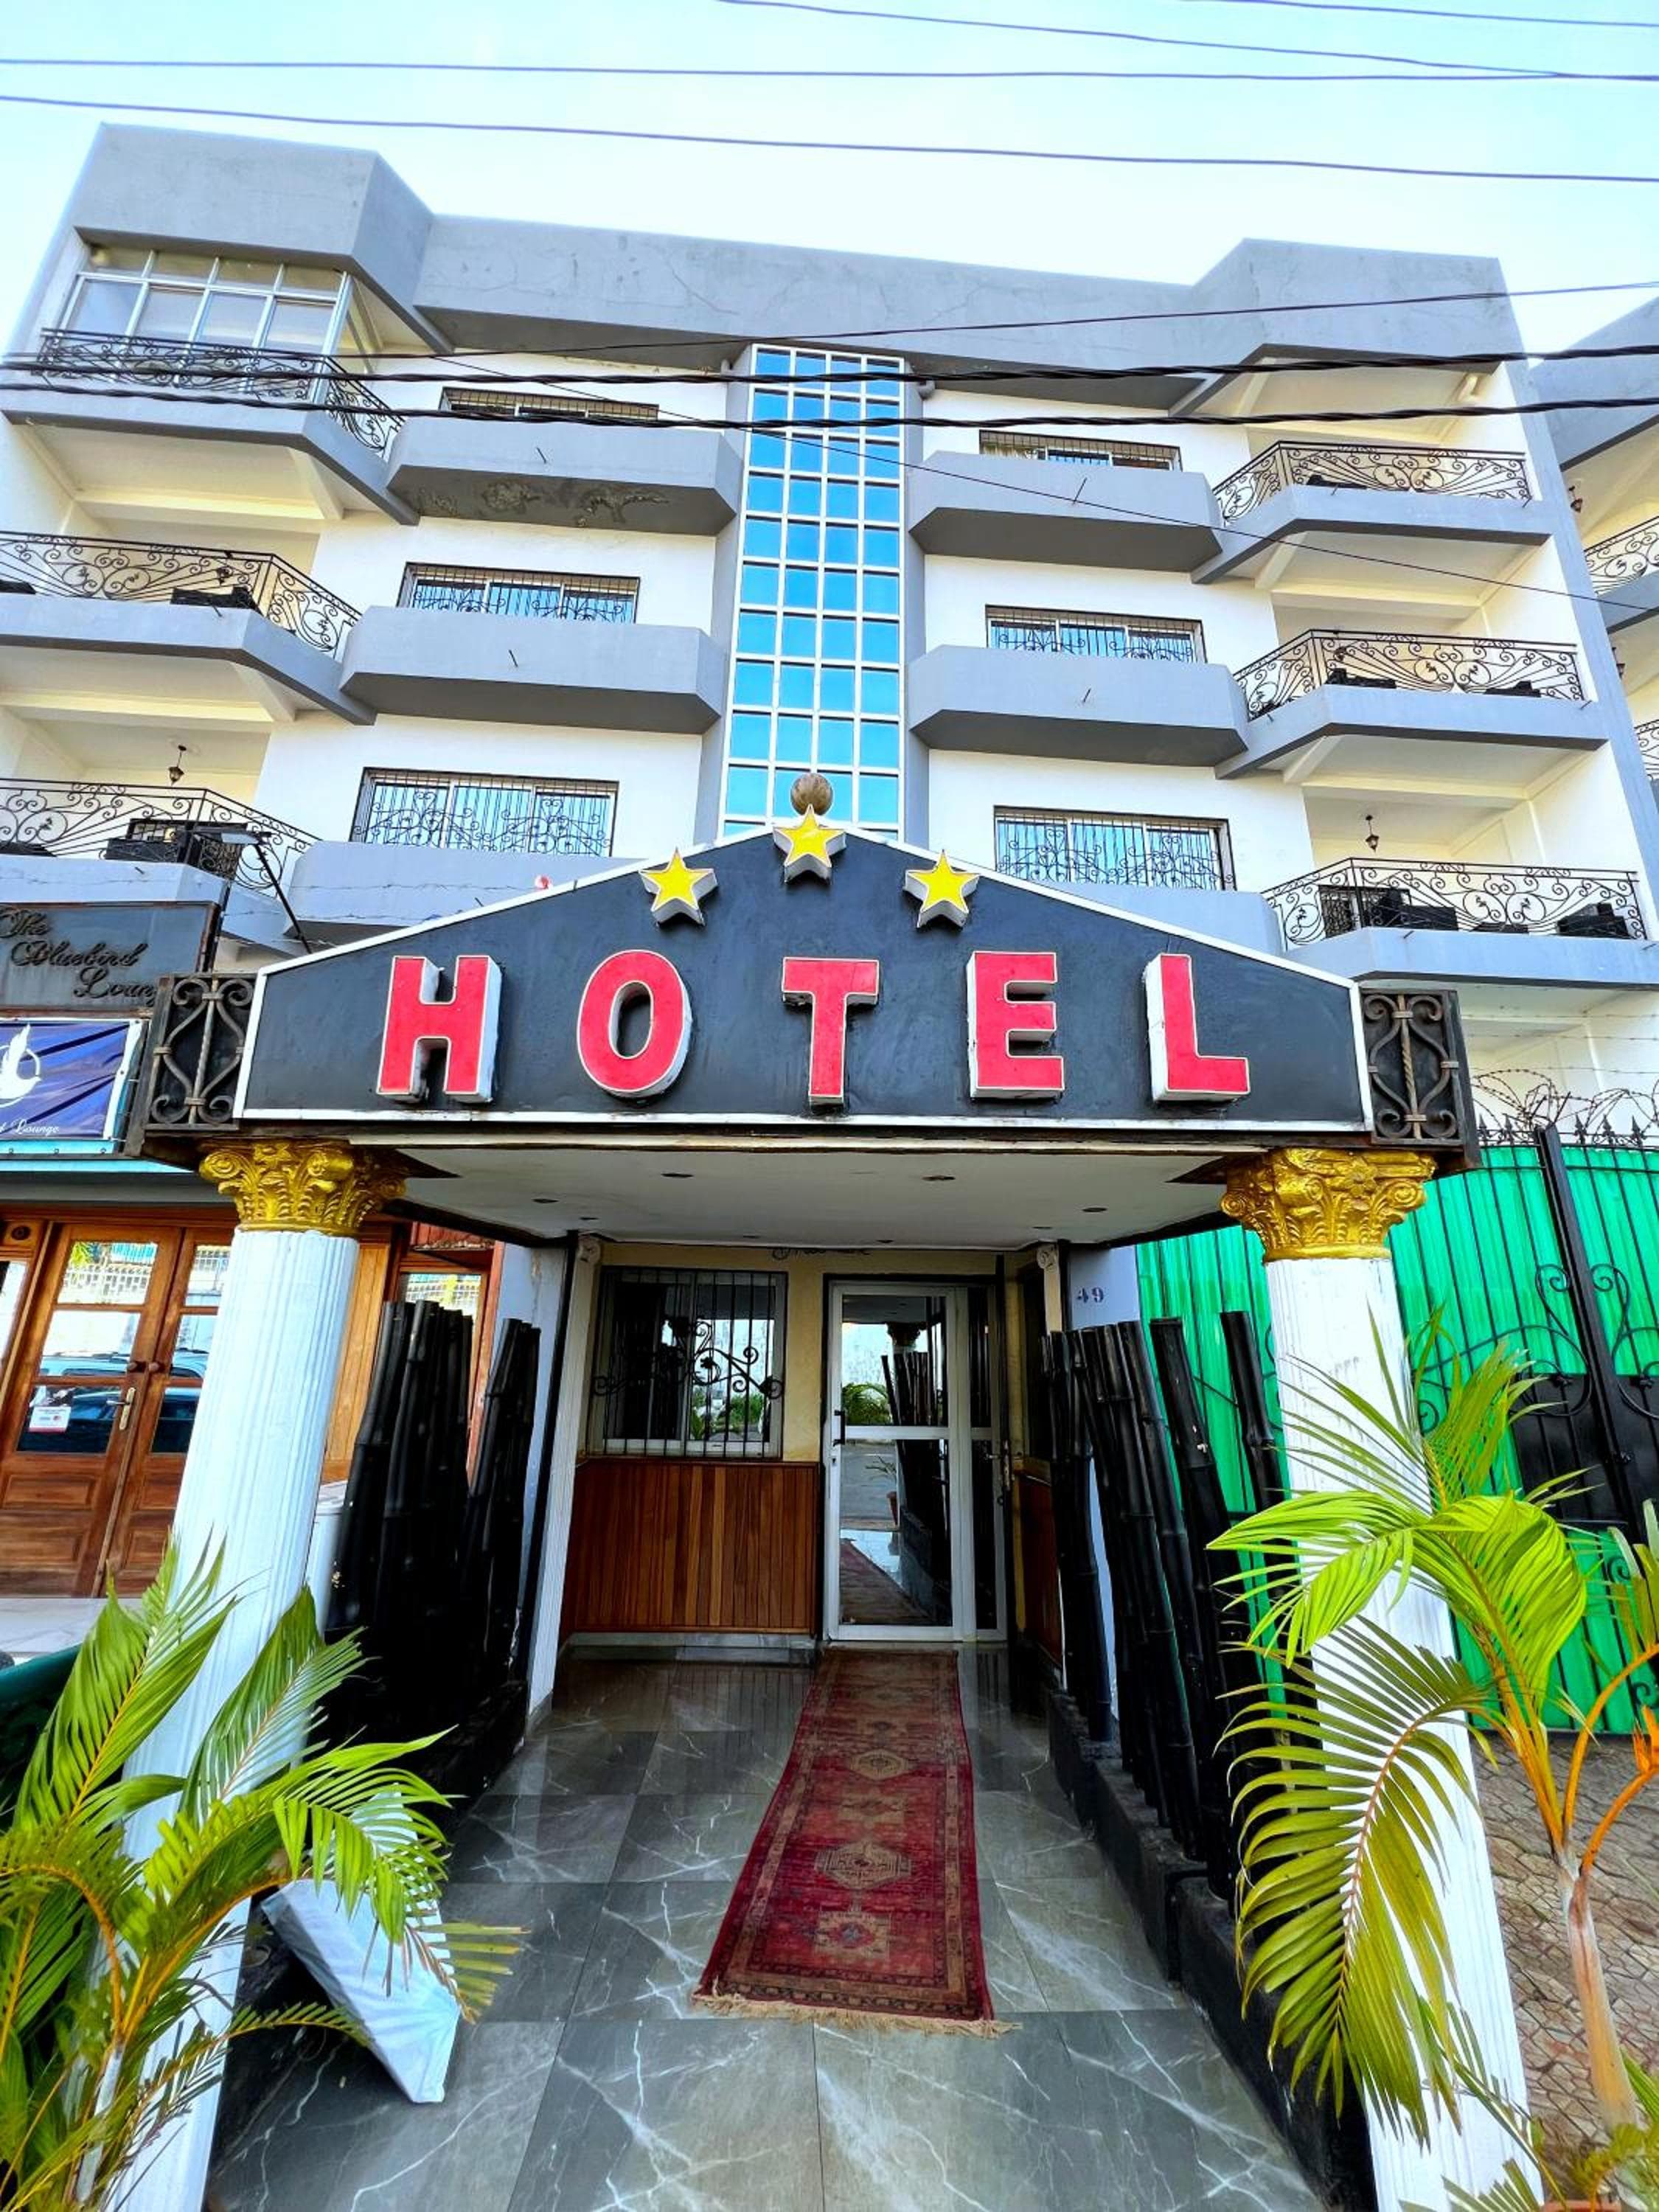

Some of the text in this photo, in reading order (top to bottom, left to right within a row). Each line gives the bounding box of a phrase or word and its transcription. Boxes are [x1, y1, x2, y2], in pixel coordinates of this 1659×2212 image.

[0, 907, 50, 939] The
[11, 939, 147, 967] Bluebird
[74, 966, 154, 1008] Loung
[377, 948, 1251, 1106] HOTEL
[10, 1118, 60, 1137] Lounge
[1077, 1287, 1105, 1304] 49
